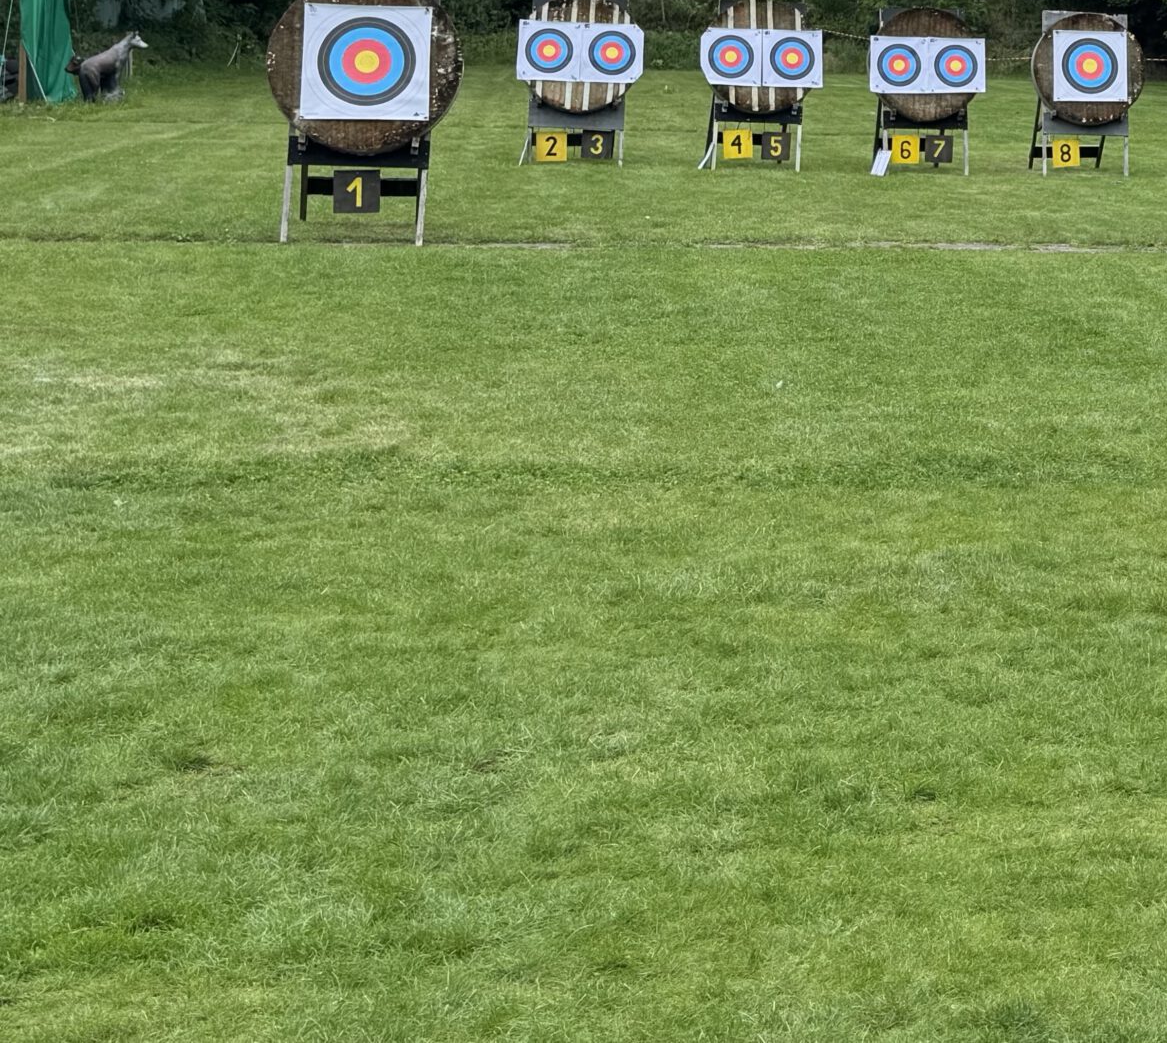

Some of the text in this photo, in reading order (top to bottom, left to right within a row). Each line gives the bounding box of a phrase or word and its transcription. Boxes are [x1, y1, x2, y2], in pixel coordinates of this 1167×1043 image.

[545, 136, 558, 157] 2
[589, 134, 604, 155] 3
[730, 134, 742, 154] 4
[770, 135, 782, 157] 5
[900, 140, 912, 159] 6
[933, 140, 946, 158] 7
[1060, 143, 1071, 163] 8
[346, 176, 362, 207] 1
